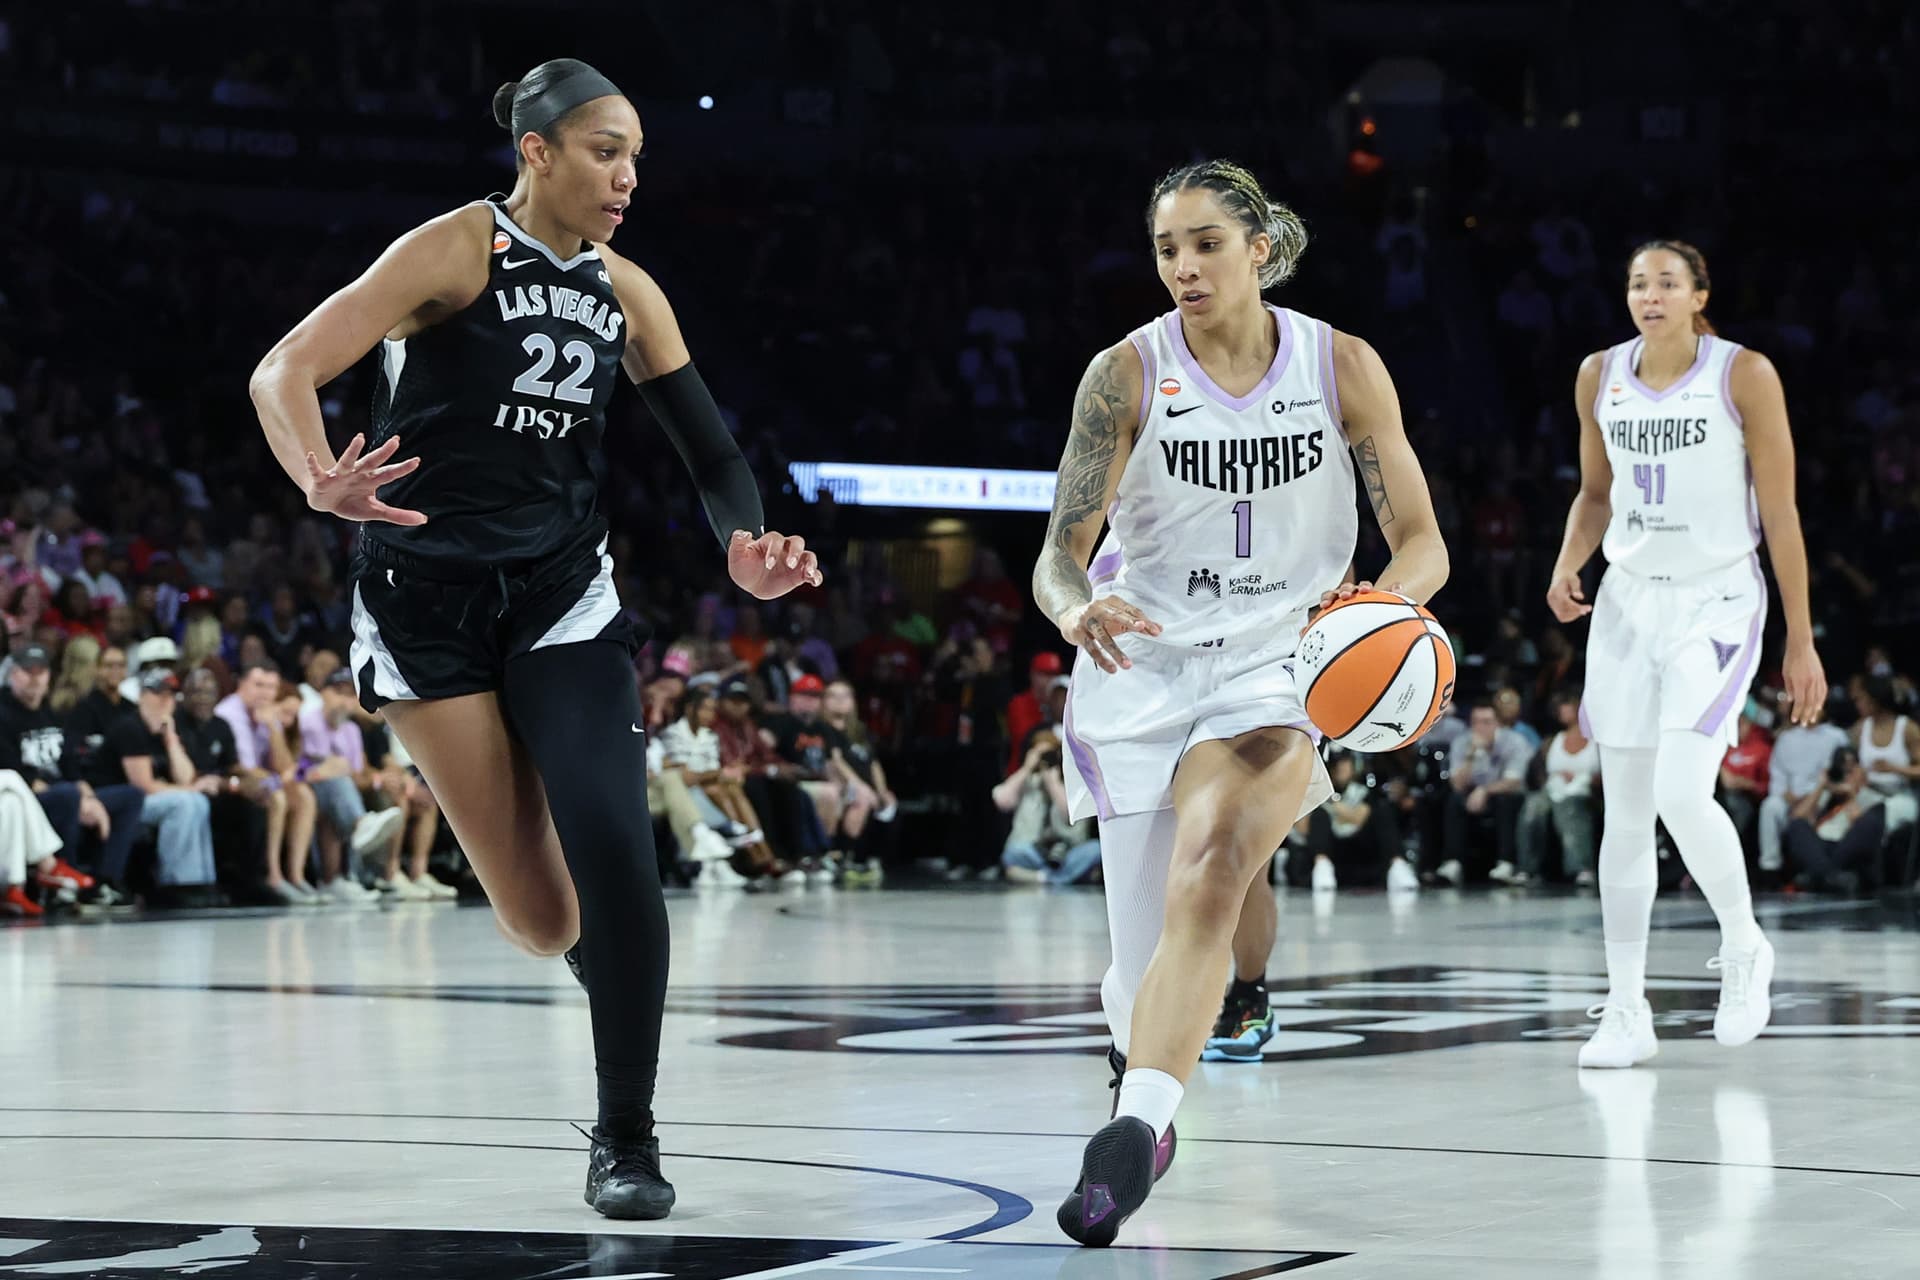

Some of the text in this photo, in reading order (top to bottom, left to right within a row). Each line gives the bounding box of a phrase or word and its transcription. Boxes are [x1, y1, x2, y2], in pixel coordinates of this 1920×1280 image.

[495, 284, 624, 342] LAS VEGAS
[513, 333, 595, 404] 22
[493, 403, 590, 439] IPSY
[1608, 418, 1707, 456] VALKYRIES
[1159, 430, 1323, 494] VALKYRIES
[1633, 464, 1665, 504] 41
[1231, 500, 1251, 558] 1
